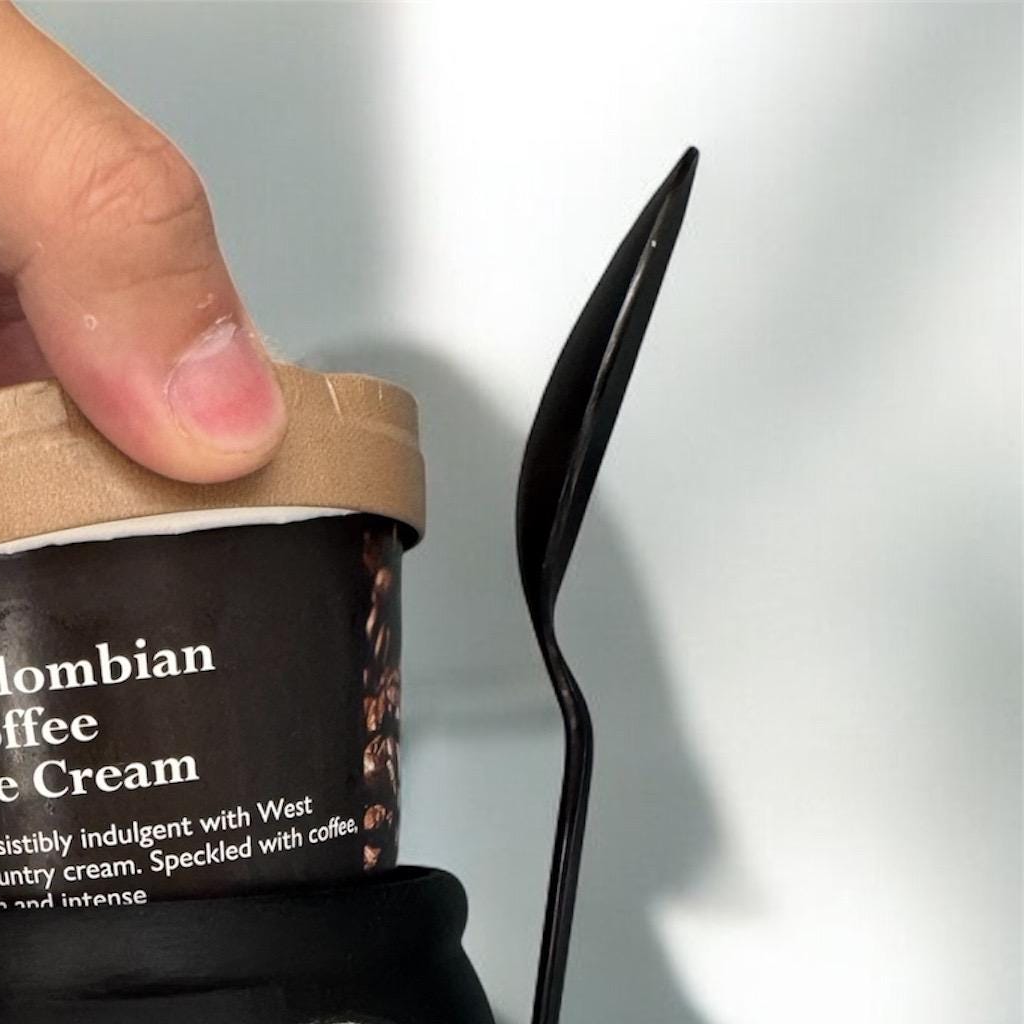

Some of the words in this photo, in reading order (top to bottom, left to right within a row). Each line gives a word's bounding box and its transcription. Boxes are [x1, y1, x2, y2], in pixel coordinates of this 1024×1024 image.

[32, 755, 200, 799] Cream
[80, 820, 194, 848] indulgent
[199, 805, 251, 833] with
[256, 796, 313, 823] West
[63, 859, 143, 881] cream.
[149, 835, 252, 877] Speckled
[258, 827, 303, 854] with
[308, 816, 358, 844] coffee,
[62, 889, 148, 908] intense
